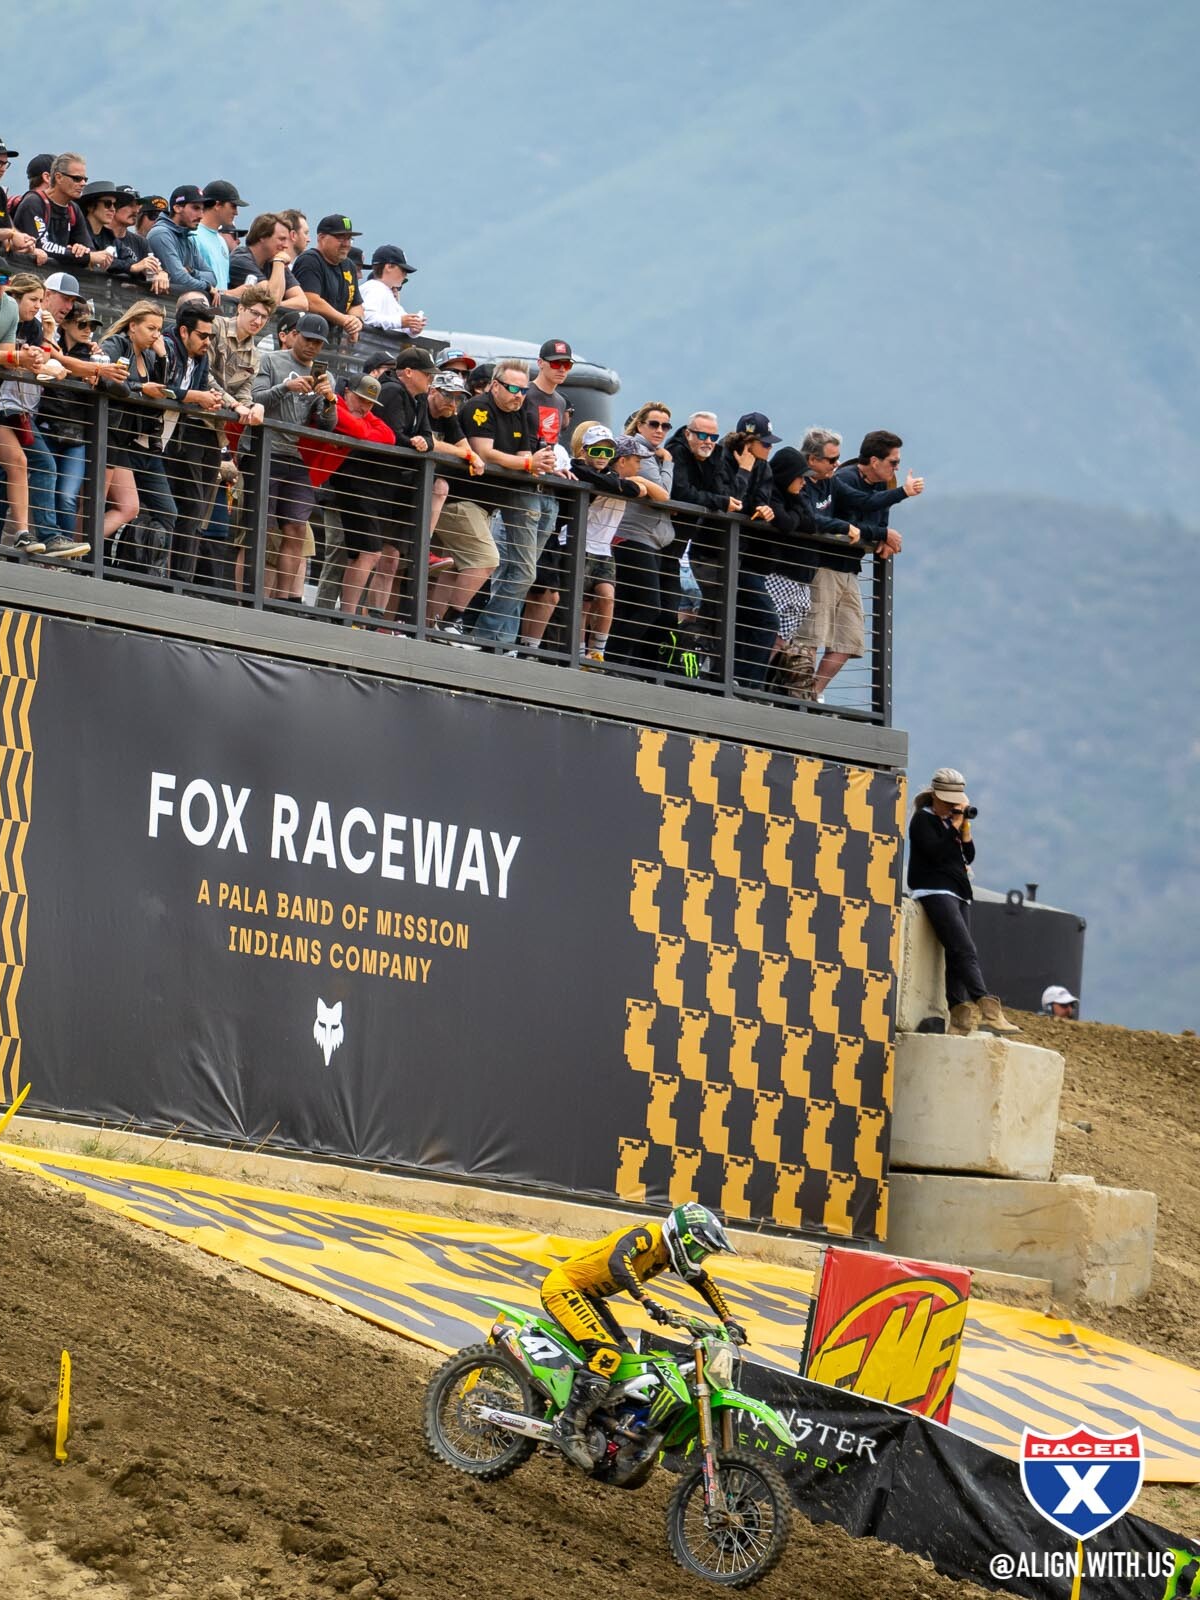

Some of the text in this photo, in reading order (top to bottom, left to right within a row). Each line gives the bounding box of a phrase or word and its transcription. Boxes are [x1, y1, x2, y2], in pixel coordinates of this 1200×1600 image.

[147, 771, 522, 899] FOX RACEWAY
[197, 879, 469, 950] A PALA BAND OF MISSION
[228, 925, 432, 984] INDIANS COMPANY
[519, 1336, 564, 1361] 47
[737, 1432, 849, 1475] ENERGY
